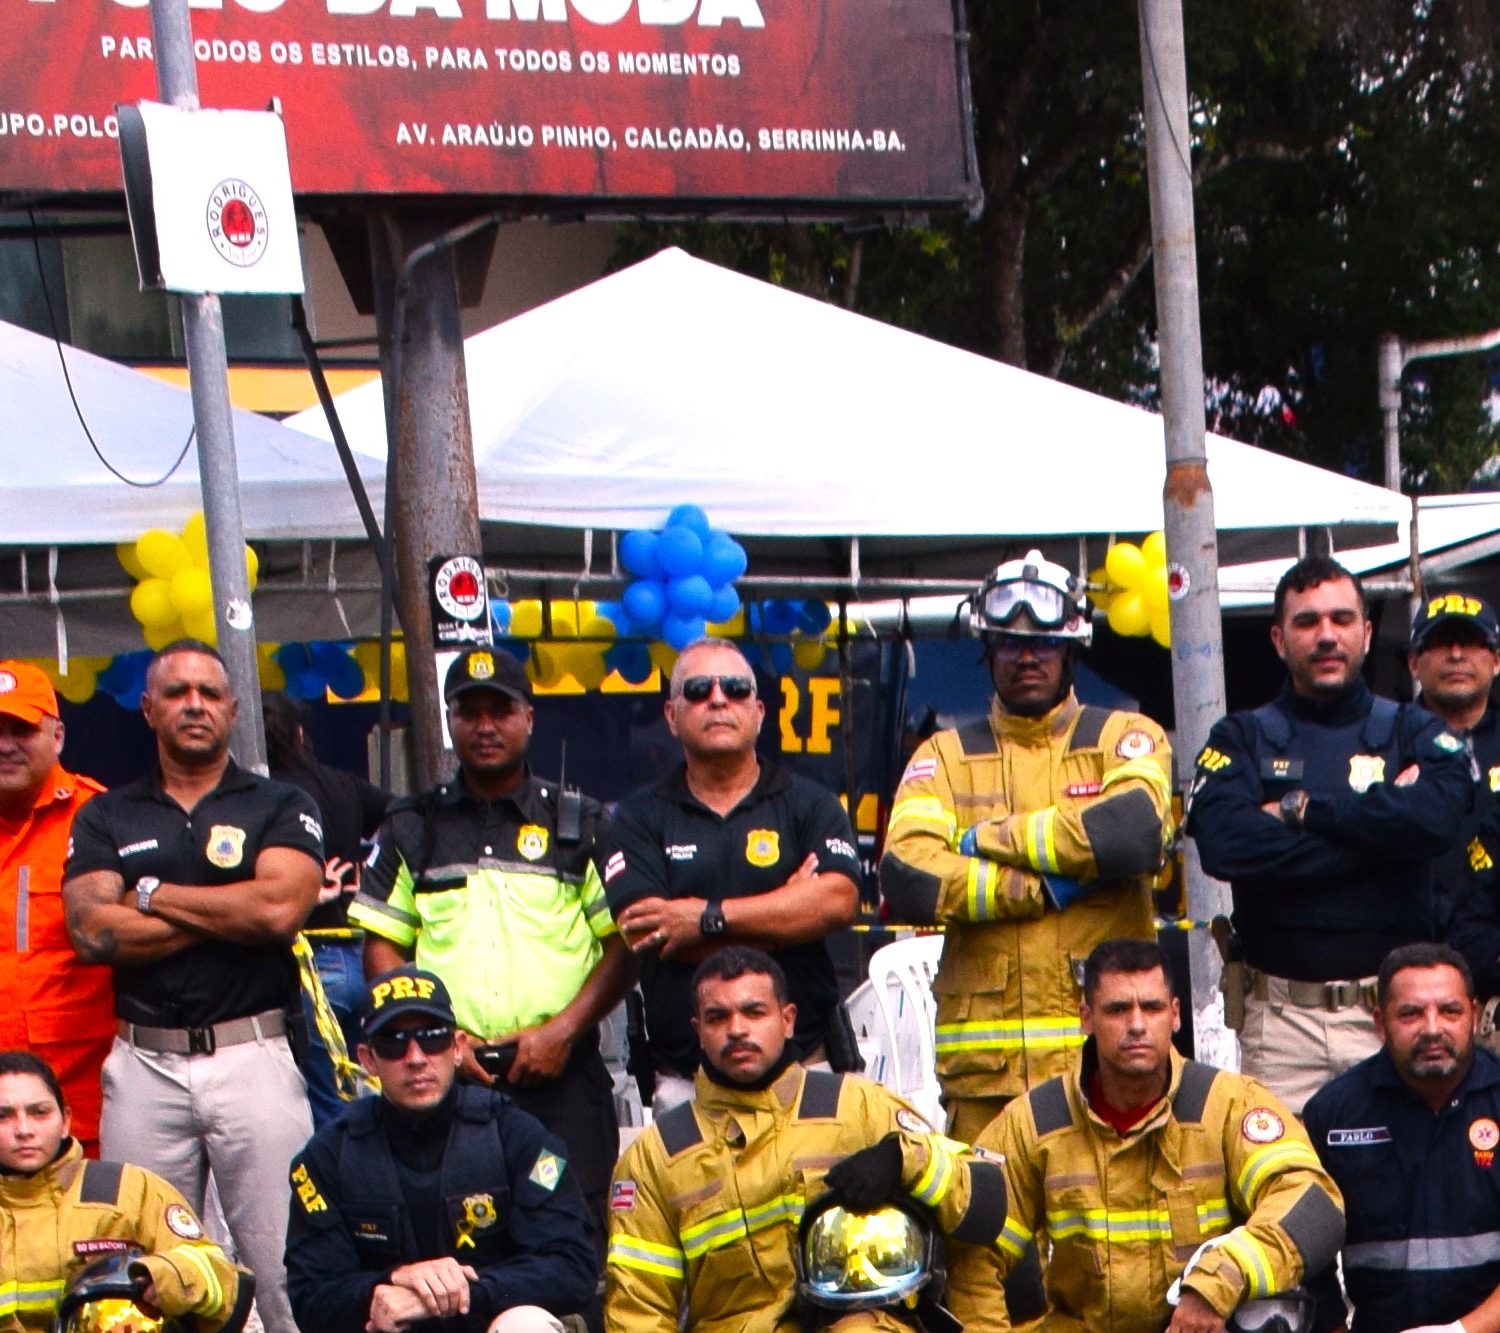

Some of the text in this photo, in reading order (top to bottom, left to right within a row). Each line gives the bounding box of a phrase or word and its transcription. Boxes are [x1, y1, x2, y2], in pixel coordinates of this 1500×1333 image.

[101, 35, 740, 76] PAR ODOS OS ESTILOS, PARA TODOS OS MOMENTOS
[397, 119, 906, 152] AV. ARAÚJO PINHO, CALÇADÃO, SERRINHA-BA.
[209, 182, 266, 238] RODRIGUES
[1427, 594, 1482, 619] PRF
[372, 975, 436, 1009] PRF
[1340, 1132, 1374, 1144] PABLO
[291, 1163, 328, 1214] PRF
